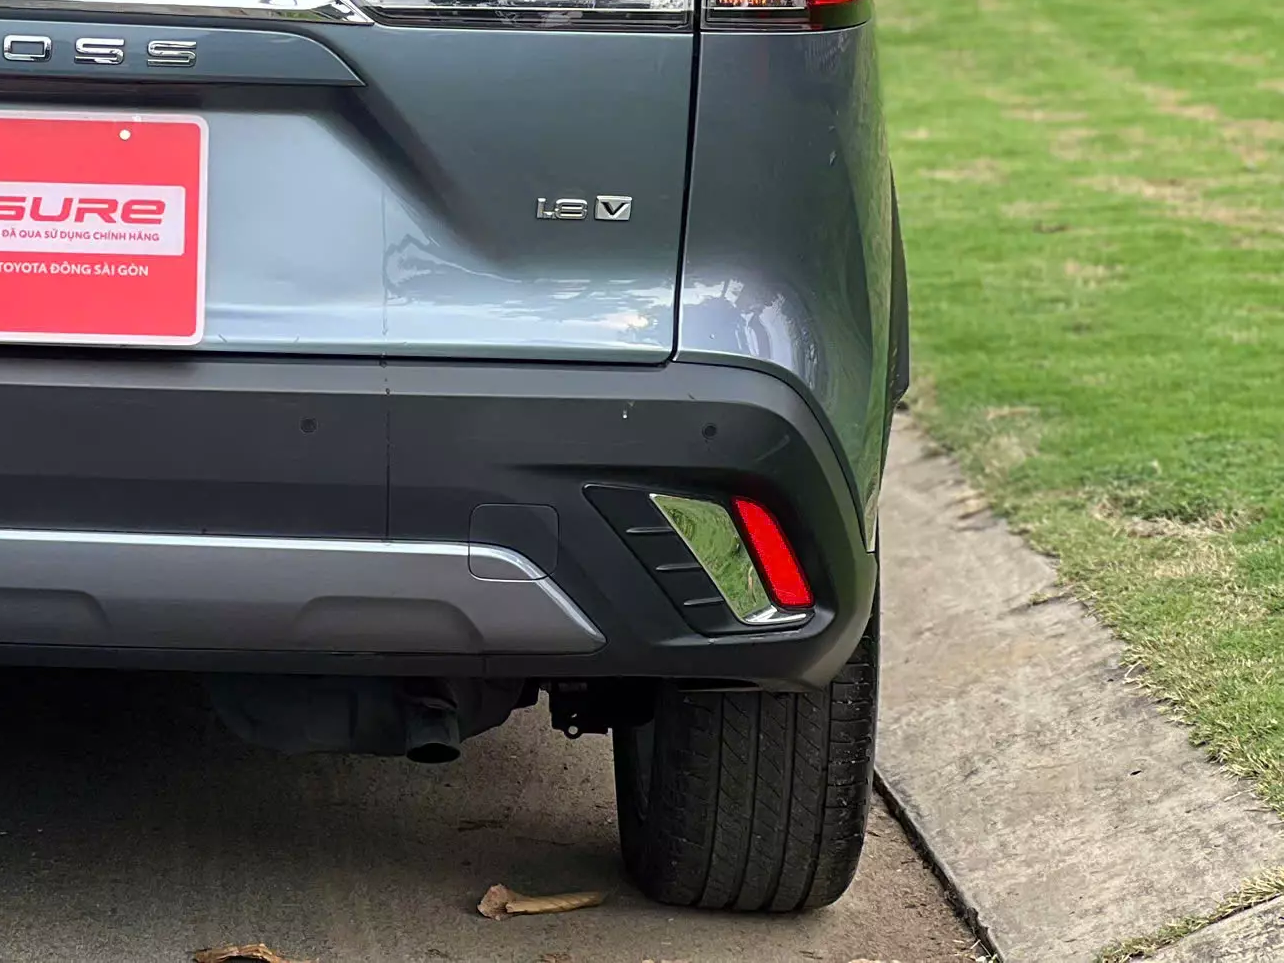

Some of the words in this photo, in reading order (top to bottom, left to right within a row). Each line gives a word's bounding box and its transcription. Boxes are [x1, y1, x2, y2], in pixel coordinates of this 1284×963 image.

[536, 197, 588, 220] 1.8
[598, 198, 631, 219] V
[1, 227, 17, 238] ĐÃ
[19, 229, 42, 239] QUA
[59, 230, 91, 242] DỤNG
[93, 230, 126, 241] CHÍNH
[50, 260, 92, 275] ĐÔNG
[94, 261, 115, 276] SÀI
[118, 263, 149, 276] GÒN
